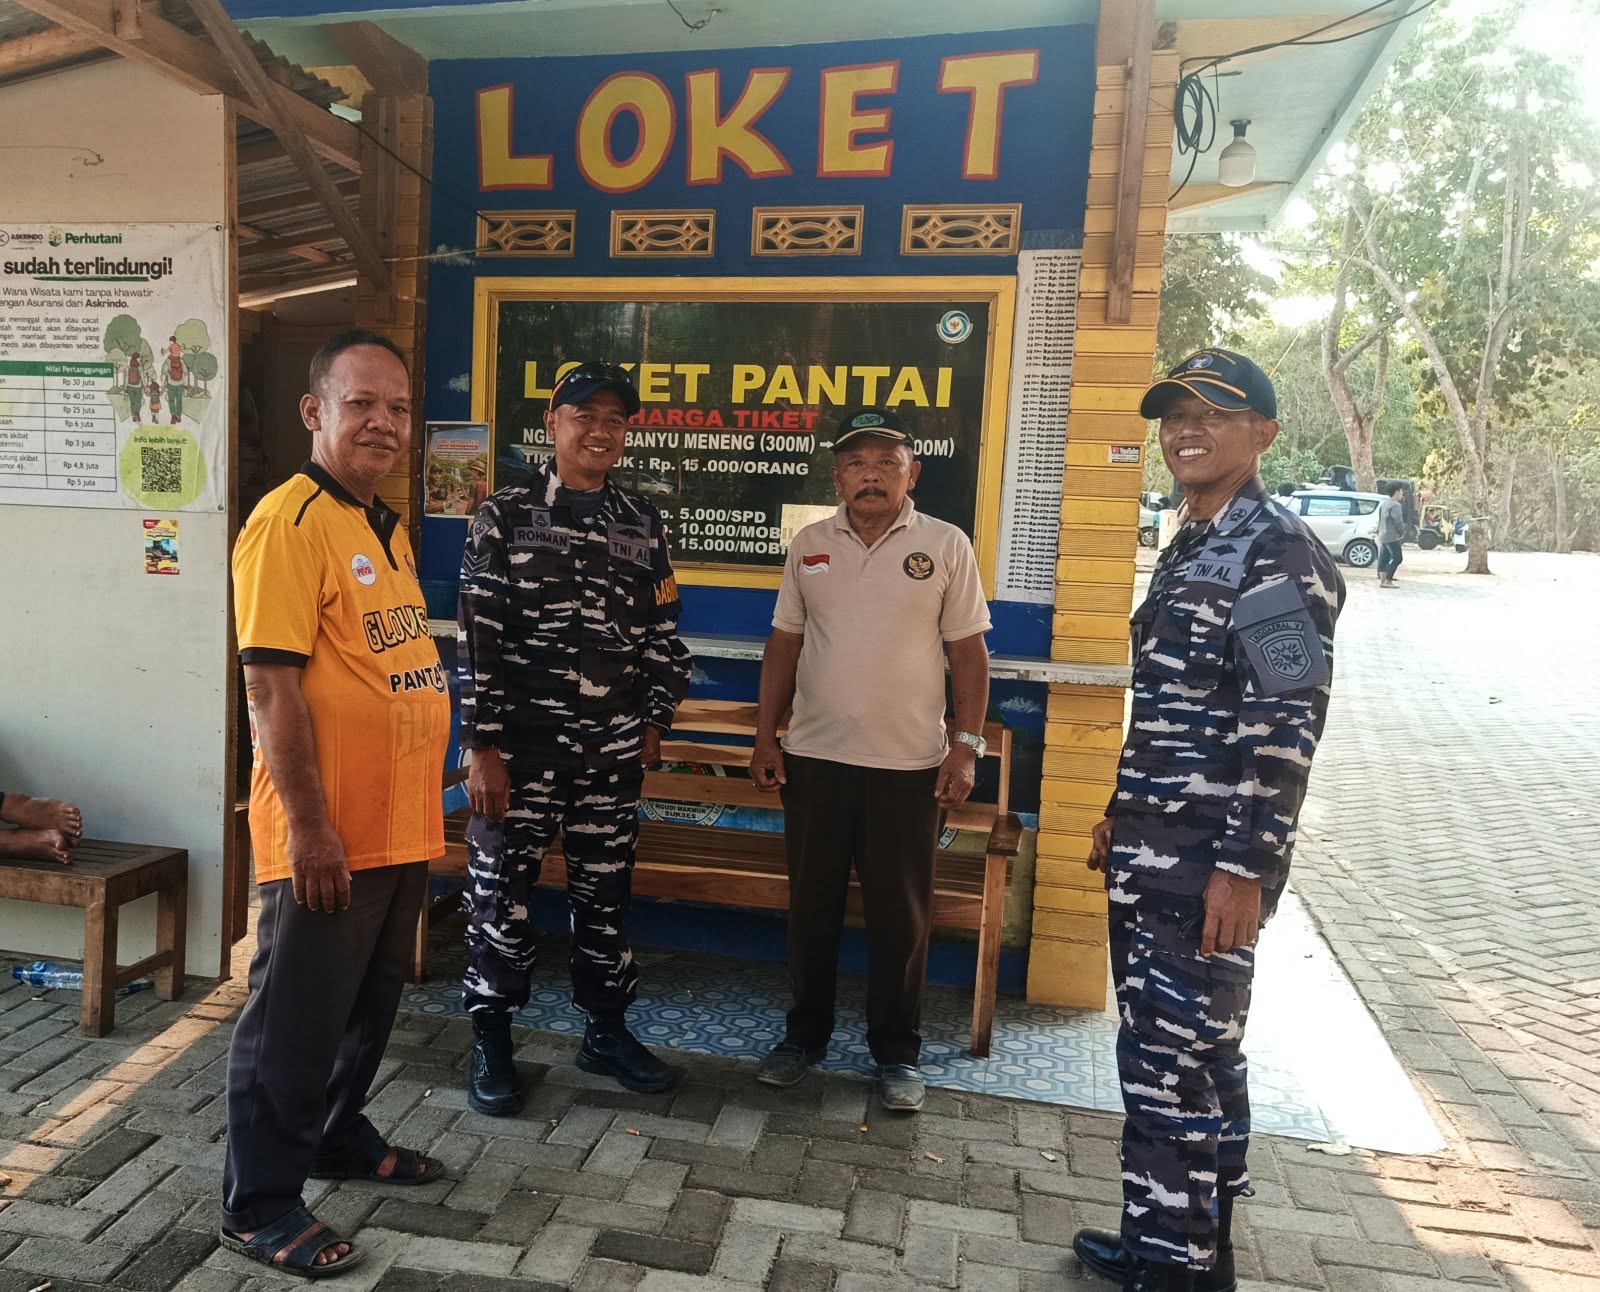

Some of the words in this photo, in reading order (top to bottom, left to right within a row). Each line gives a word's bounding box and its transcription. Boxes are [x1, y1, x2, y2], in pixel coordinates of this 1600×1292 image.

[475, 49, 1040, 193] LOKET
[65, 232, 122, 244] Perhutani
[4, 256, 60, 275] sudah
[64, 256, 172, 280] terlindungi!
[2, 288, 28, 296] Wana
[30, 288, 61, 296] Wisata
[63, 288, 84, 296] kami
[86, 288, 112, 298] tanpa
[114, 288, 154, 298] khawatir
[26, 298, 64, 308] Asuransi
[66, 299, 83, 308] dari
[86, 299, 129, 308] Askrindo.
[62, 366, 112, 375] Pertanggungan
[62, 378, 71, 387] Rp
[82, 379, 95, 387] juta
[524, 360, 711, 403] LET
[731, 364, 953, 408] PANTAI
[82, 393, 95, 401] juta
[63, 406, 71, 414] Rp
[82, 407, 95, 415] juta
[65, 420, 73, 428] Rp
[80, 420, 94, 429] juta
[627, 408, 730, 428] HARGA
[733, 409, 819, 430] TIKET
[65, 439, 73, 448] Rp
[81, 440, 95, 448] juta
[624, 431, 679, 449] BANYU
[684, 433, 756, 450] MENENG
[760, 435, 816, 455] (300M)
[64, 462, 72, 470] Rp
[86, 462, 99, 470] juta
[649, 457, 676, 473] Rp.
[682, 458, 698, 472] 15
[702, 460, 809, 476] .000/ORANG
[67, 479, 75, 487] Rp
[82, 479, 96, 487] juta
[680, 508, 766, 524] 5.000/SPD
[517, 530, 568, 548] ROHMAN
[612, 542, 632, 556] TNI
[635, 548, 649, 563] AL
[1193, 563, 1211, 578] TNI
[1212, 564, 1232, 582] AL
